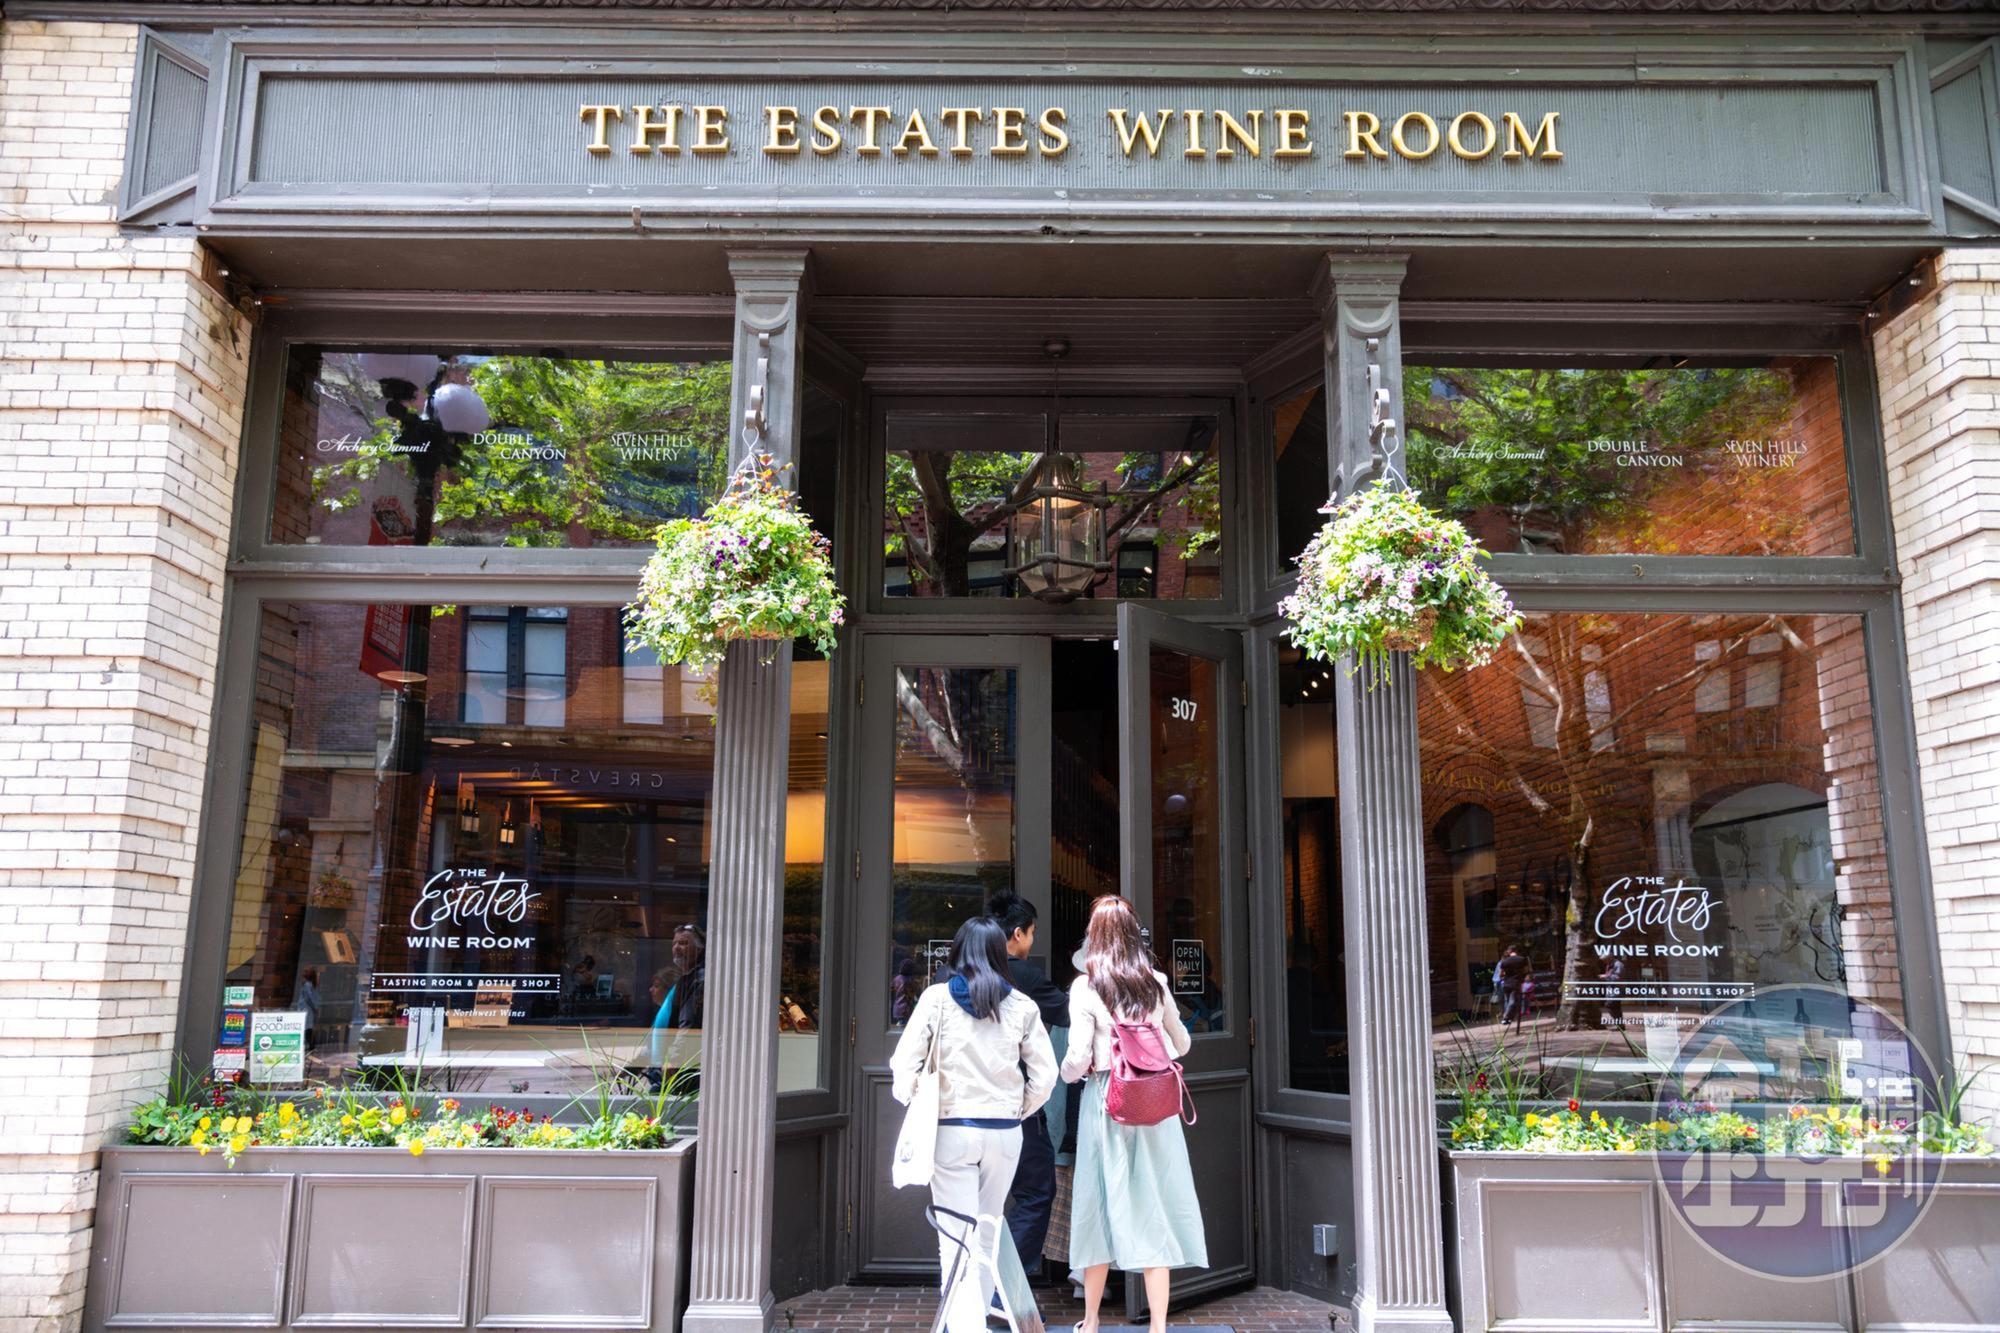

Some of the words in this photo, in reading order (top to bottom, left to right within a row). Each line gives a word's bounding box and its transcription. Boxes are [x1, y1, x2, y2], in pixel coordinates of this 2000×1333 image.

[579, 104, 729, 154] THE
[762, 105, 1069, 157] ESTATES
[1107, 108, 1314, 158] WINE
[1343, 110, 1563, 160] ROOM
[317, 433, 379, 457] Archery
[379, 437, 431, 454] Summit
[473, 433, 534, 446] DOUBLE
[611, 433, 648, 448] SEVEN
[653, 433, 693, 448] HILLS
[1433, 440, 1493, 463] Archery
[1494, 442, 1545, 461] Summit
[1588, 440, 1648, 453] DOUBLE
[1725, 440, 1763, 454] SEVEN
[1768, 440, 1808, 455] HILLS
[500, 448, 567, 461] CANYON
[620, 448, 681, 462] WINERY
[1617, 455, 1683, 467] CANYON
[1736, 454, 1796, 468] WINERY
[1171, 696, 1197, 722] 307
[458, 868, 487, 877] THE
[1635, 876, 1665, 886] THE
[410, 869, 541, 935] Estates
[1594, 877, 1723, 943] Estates
[407, 936, 460, 949] WINE
[1176, 946, 1200, 958] OPEN
[1594, 944, 1648, 957] WINE
[1177, 960, 1200, 971] DAILY
[382, 978, 427, 987] TASTING
[431, 978, 462, 987] ROOM
[467, 978, 473, 987] &
[478, 979, 517, 987] BOTTLE
[522, 979, 551, 988] SHOP
[1575, 986, 1622, 995] TASTING
[1625, 987, 1656, 995] ROOM
[1661, 987, 1667, 995] &
[1672, 987, 1711, 996] BOTTLE
[1716, 987, 1745, 996] SHOP
[453, 1008, 496, 1017] Northwest
[500, 1009, 526, 1017] Wines
[255, 1022, 283, 1032] FOOD
